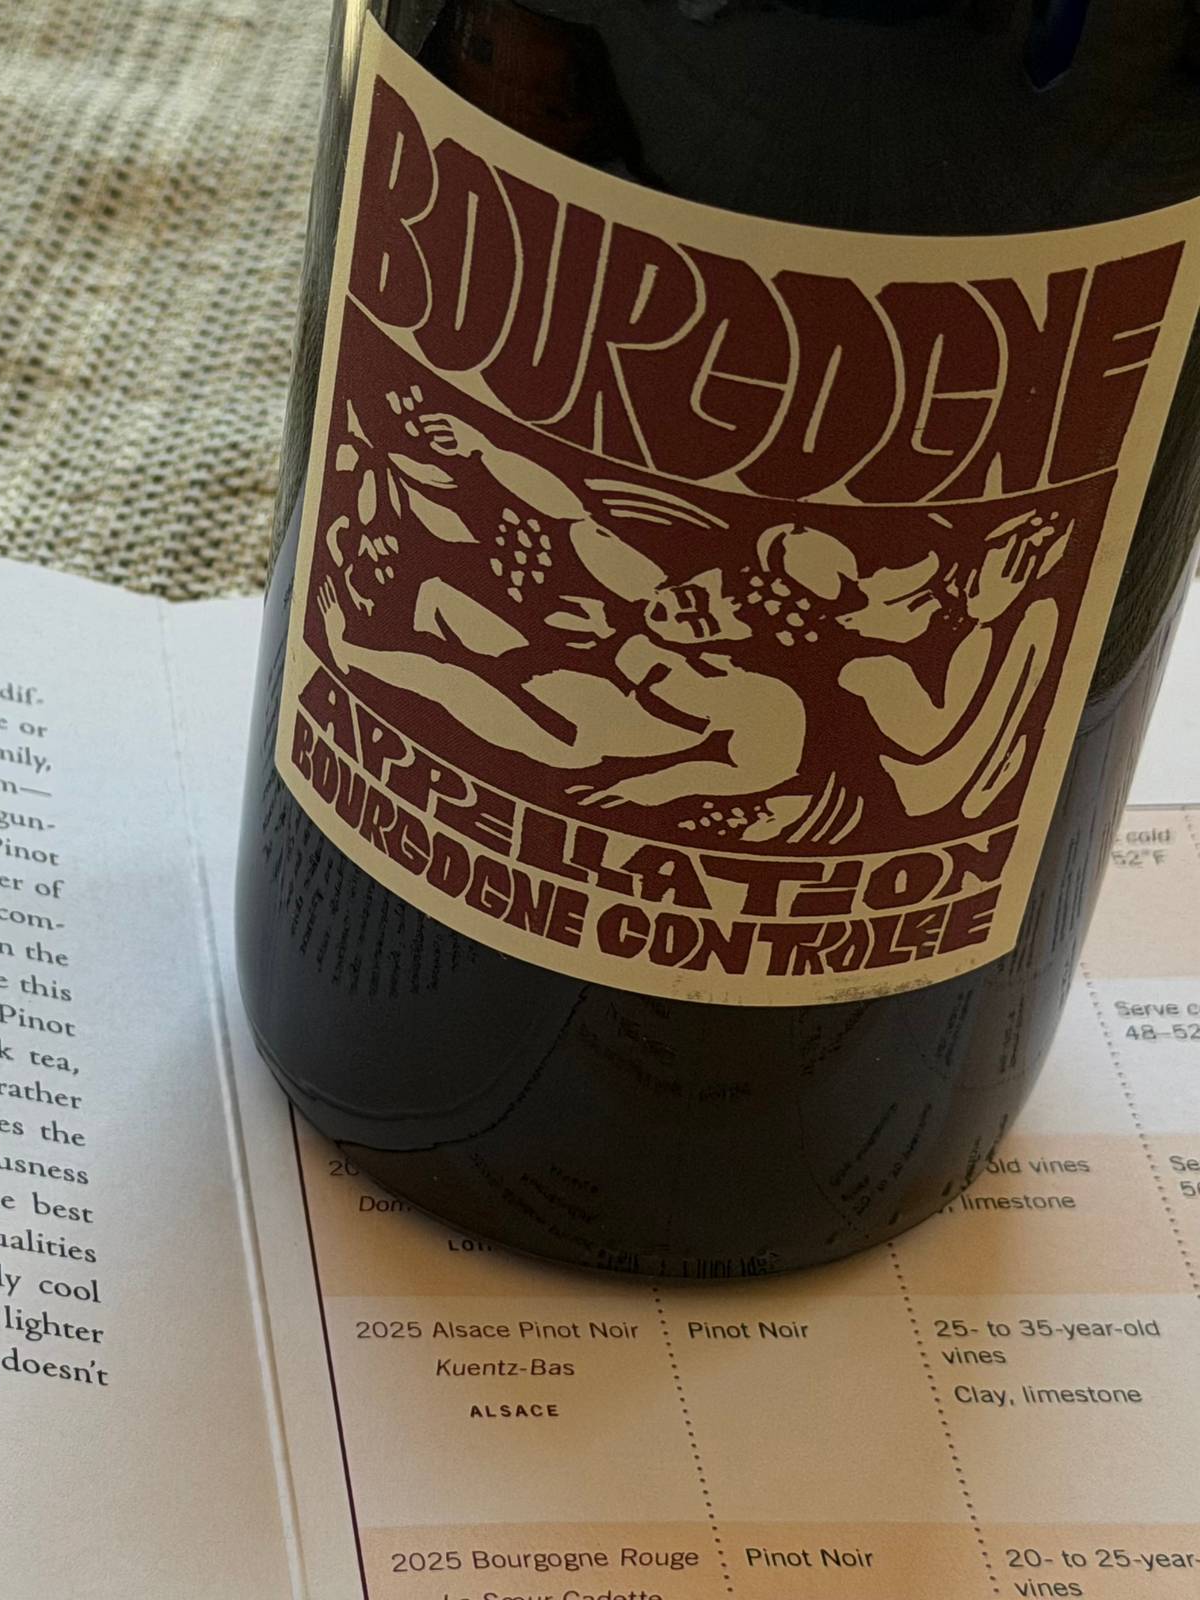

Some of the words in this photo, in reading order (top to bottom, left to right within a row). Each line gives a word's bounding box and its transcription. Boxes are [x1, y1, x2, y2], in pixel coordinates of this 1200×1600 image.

[348, 75, 1185, 503] BOURGOGNE
[298, 666, 1019, 918] APPELLATION
[291, 709, 589, 948] BOURGOGNE
[20, 974, 72, 1002] this
[1114, 1000, 1180, 1018] Serve
[40, 1120, 85, 1147] the
[1028, 1156, 1091, 1175] vines
[32, 1191, 93, 1223] best
[961, 1194, 1077, 1211] limestone
[39, 1279, 101, 1303] cool
[4, 1305, 104, 1344] lighter
[355, 1321, 423, 1340] 2025
[432, 1321, 511, 1339] Alsace
[518, 1321, 581, 1339] Pinot
[588, 1322, 639, 1339] Noir
[687, 1321, 751, 1339] Pinot
[758, 1322, 809, 1339] Noir
[933, 1319, 979, 1338] 25-
[986, 1320, 1012, 1338] to
[1018, 1319, 1161, 1341] 35-year-old
[1, 1347, 109, 1384] doesn't
[941, 1346, 1007, 1365] vines
[435, 1358, 575, 1377] Kuentz-Bas
[953, 1385, 1015, 1408] Clay,
[1021, 1385, 1143, 1404] limestone
[470, 1404, 559, 1419] ALSACE
[391, 1550, 462, 1573] 2025
[471, 1550, 609, 1573] Bourgogne
[620, 1547, 700, 1571] Rouge
[745, 1547, 813, 1568] Pinot
[819, 1548, 873, 1568] Noir
[1005, 1548, 1054, 1568] 20-
[1061, 1550, 1088, 1569] to
[1094, 1548, 1200, 1573] 25-year-
[1014, 1578, 1084, 1598] vines
